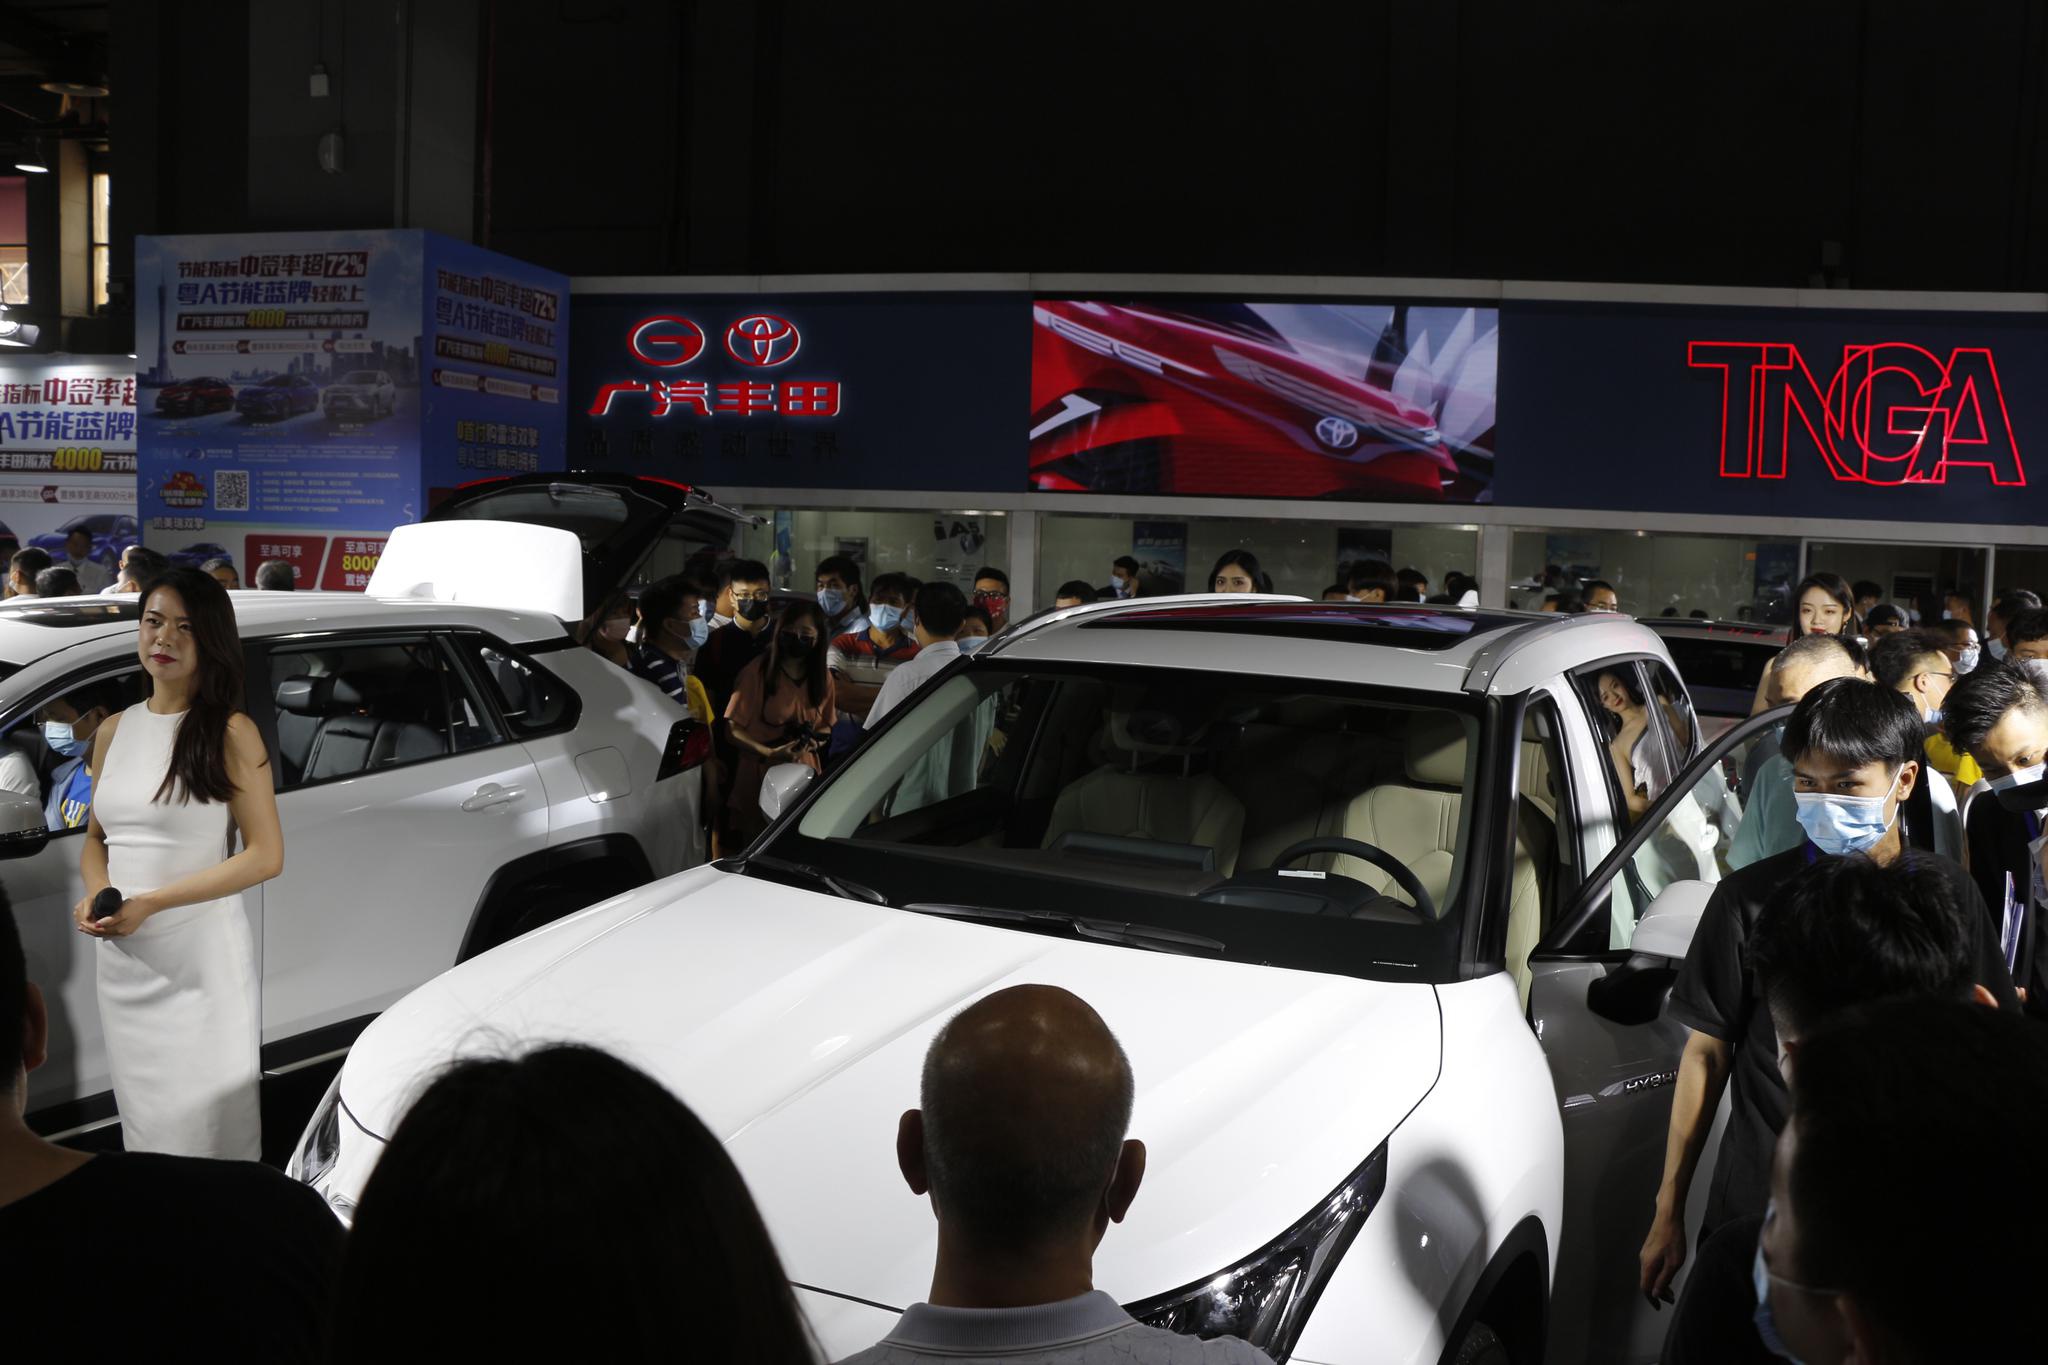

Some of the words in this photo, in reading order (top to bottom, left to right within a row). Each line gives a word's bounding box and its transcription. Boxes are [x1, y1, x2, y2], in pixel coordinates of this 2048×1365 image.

[586, 379, 842, 418] 广汽丰田
[1687, 340, 2027, 486] TNGA
[260, 544, 303, 558] 至高可享
